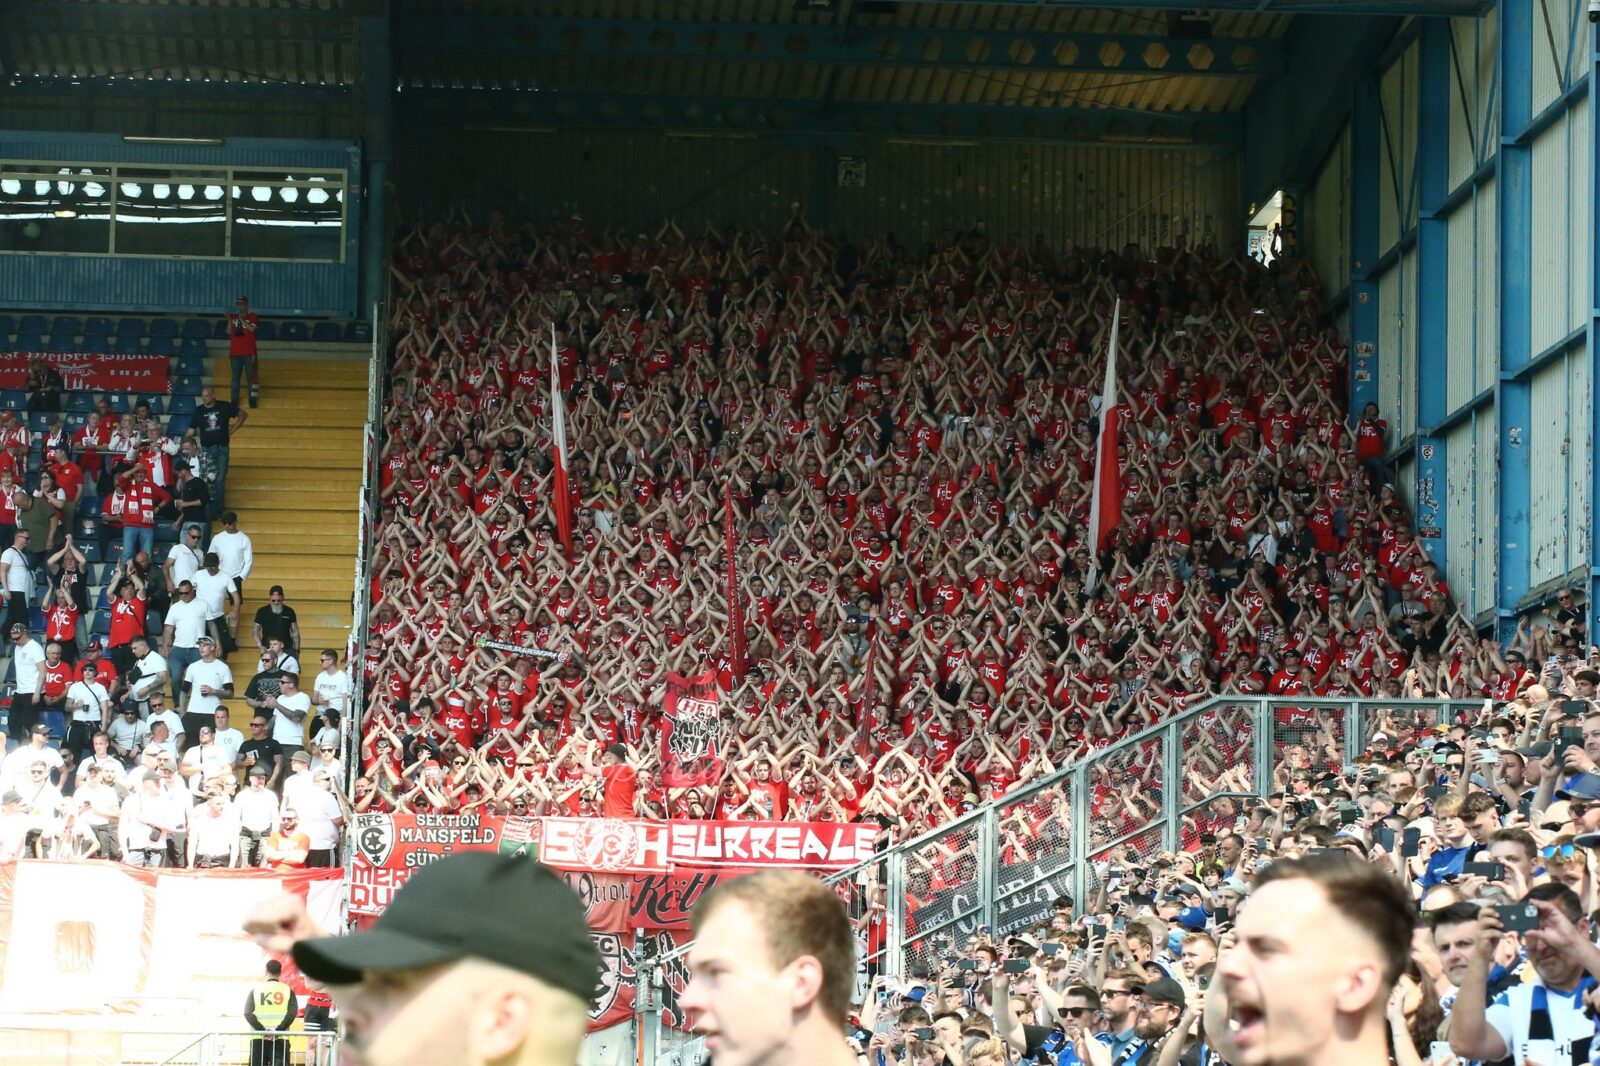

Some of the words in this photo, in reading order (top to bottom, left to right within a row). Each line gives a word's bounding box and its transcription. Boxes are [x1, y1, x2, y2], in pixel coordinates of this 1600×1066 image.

[519, 374, 534, 385] HFC
[864, 558, 882, 569] HFC
[445, 717, 465, 729] HFC
[357, 816, 383, 827] HFC
[416, 814, 480, 827] SEKTION
[400, 828, 496, 844] MANSFELD
[672, 824, 877, 860] SURREALE
[925, 914, 948, 930] HFC
[260, 992, 284, 1005] K9
